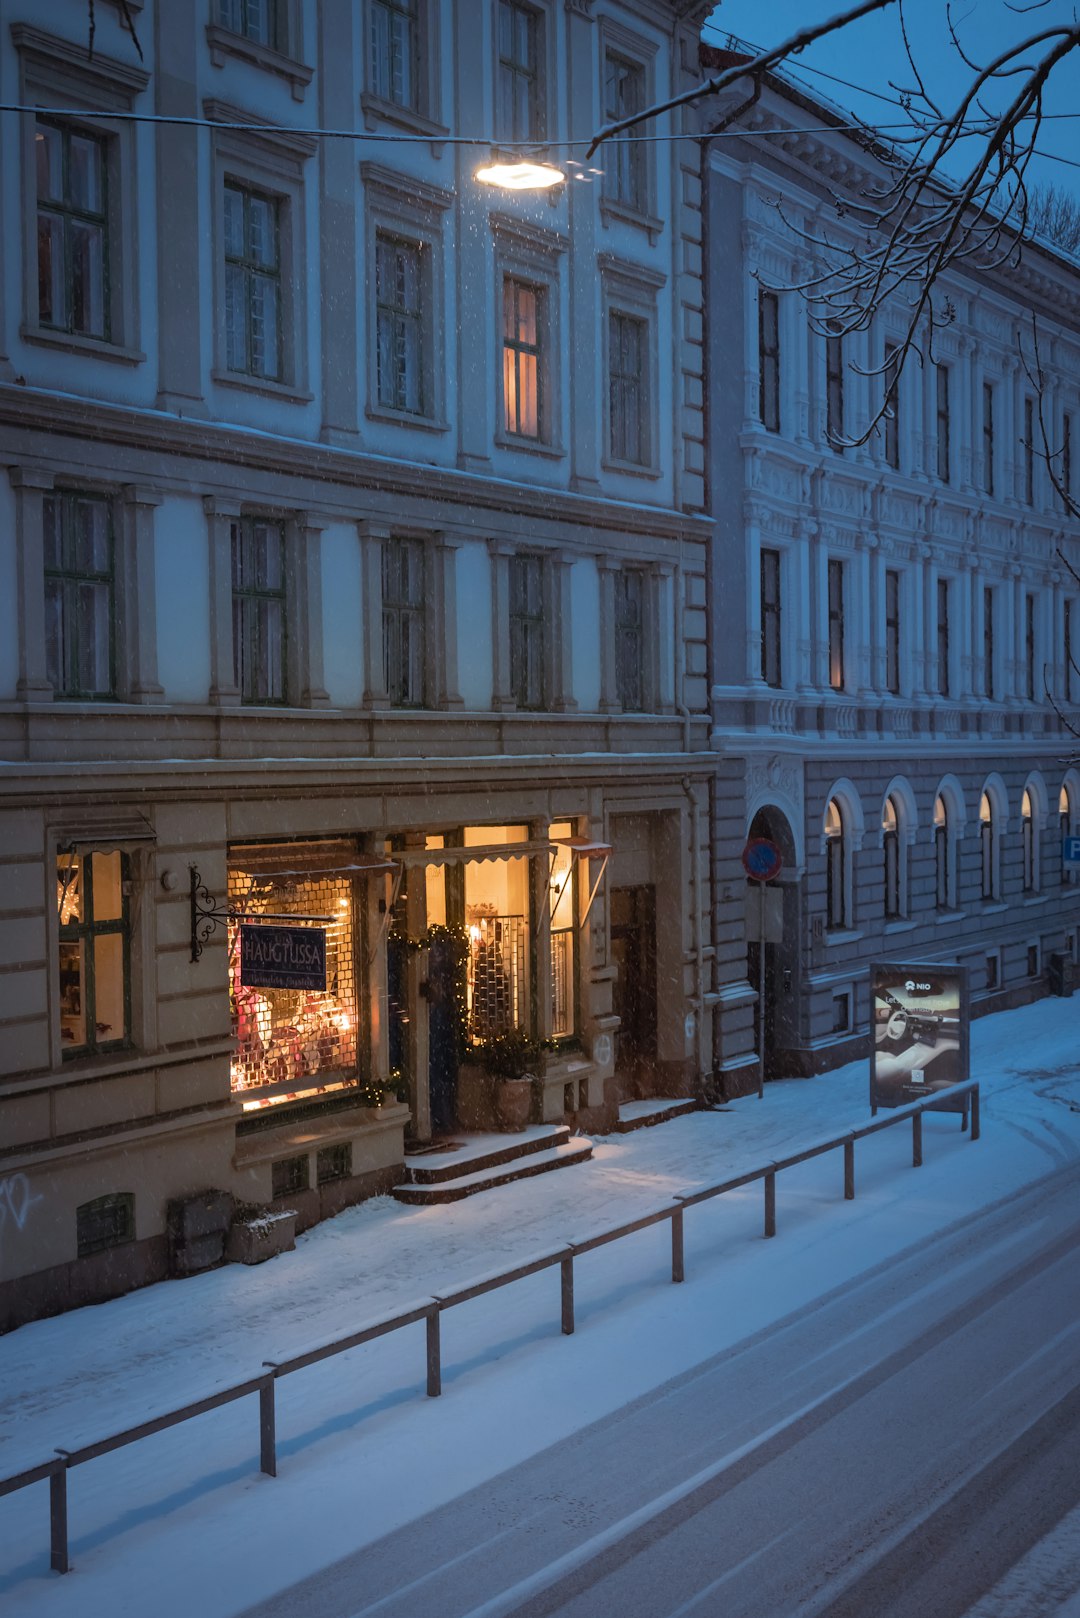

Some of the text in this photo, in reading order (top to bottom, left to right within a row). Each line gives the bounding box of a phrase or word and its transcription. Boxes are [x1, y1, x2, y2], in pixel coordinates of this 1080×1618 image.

[1071, 840, 1080, 859] P
[245, 940, 322, 965] HAUGTUSSA
[916, 983, 931, 991] NIO
